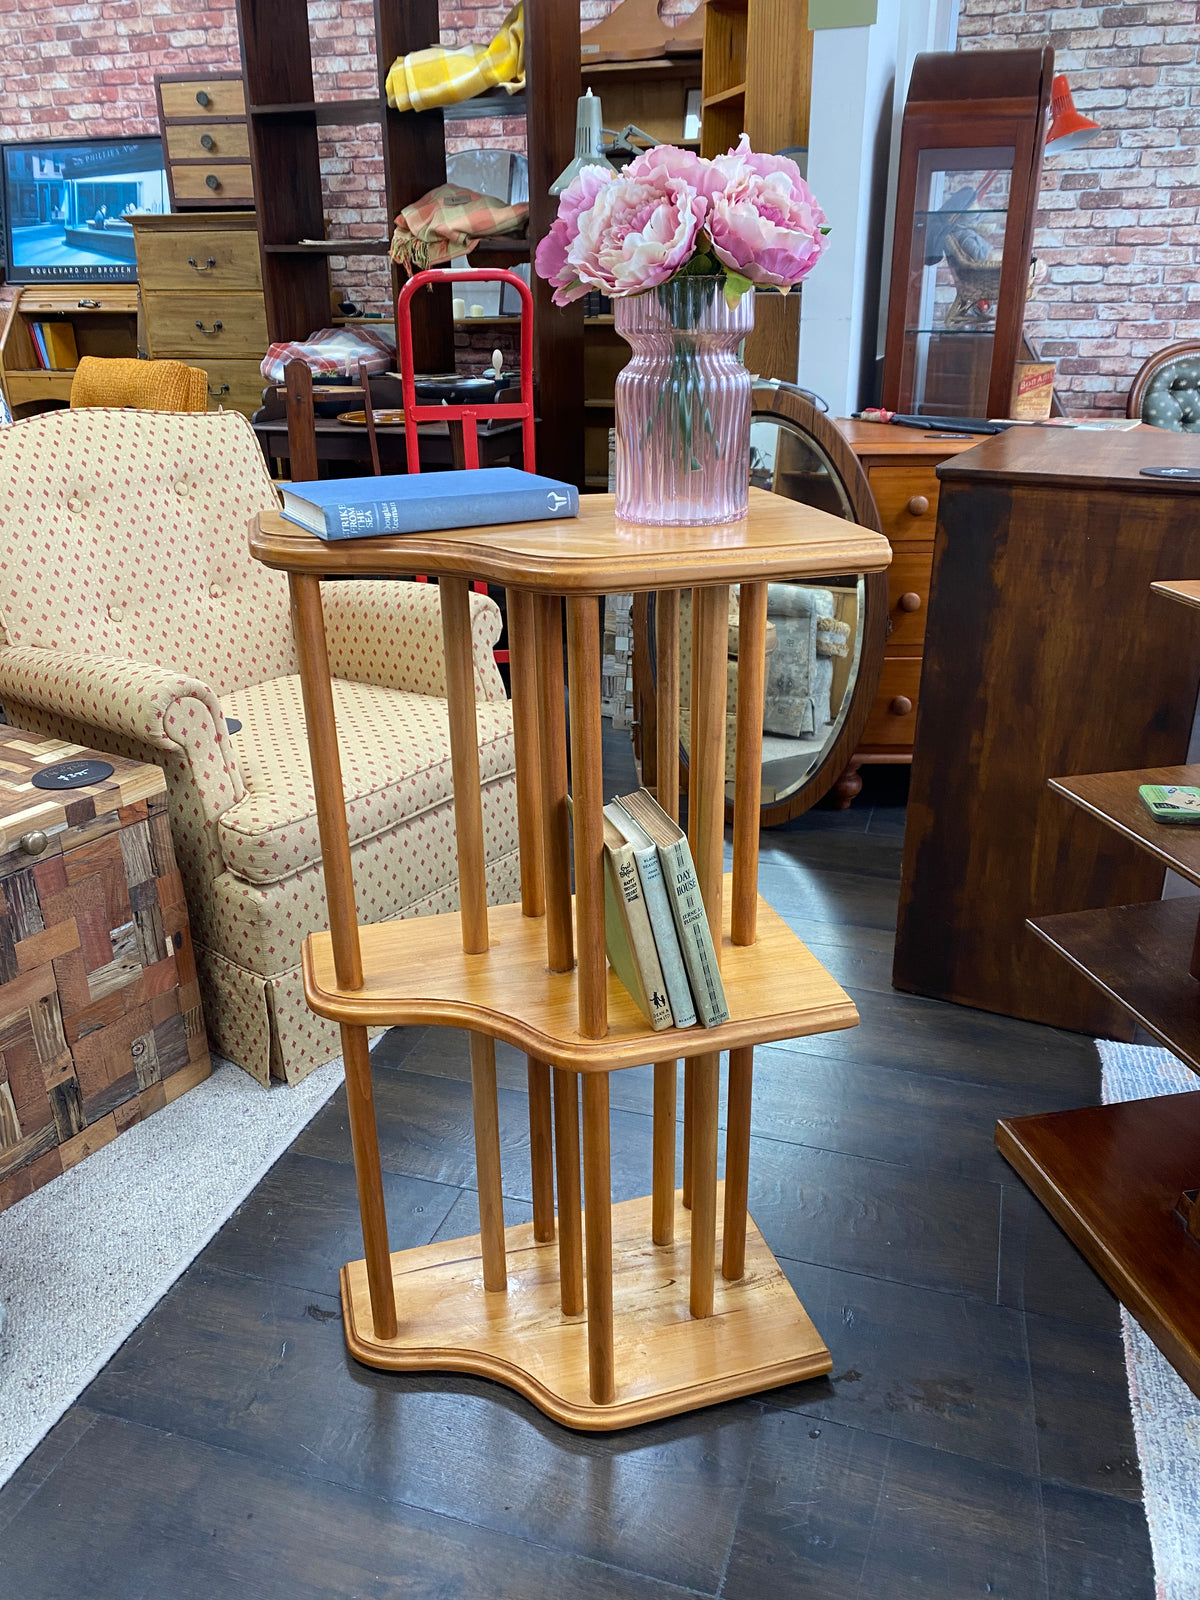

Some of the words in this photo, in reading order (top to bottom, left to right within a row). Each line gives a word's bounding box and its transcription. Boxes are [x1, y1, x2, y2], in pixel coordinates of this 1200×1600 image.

[30, 267, 79, 275] BOULEVARD
[97, 266, 131, 274] BROKEN
[346, 507, 358, 534] FROM
[356, 509, 365, 530] THE
[364, 510, 374, 528] SEA
[676, 869, 691, 884] DAY
[676, 878, 697, 896] HOUSE
